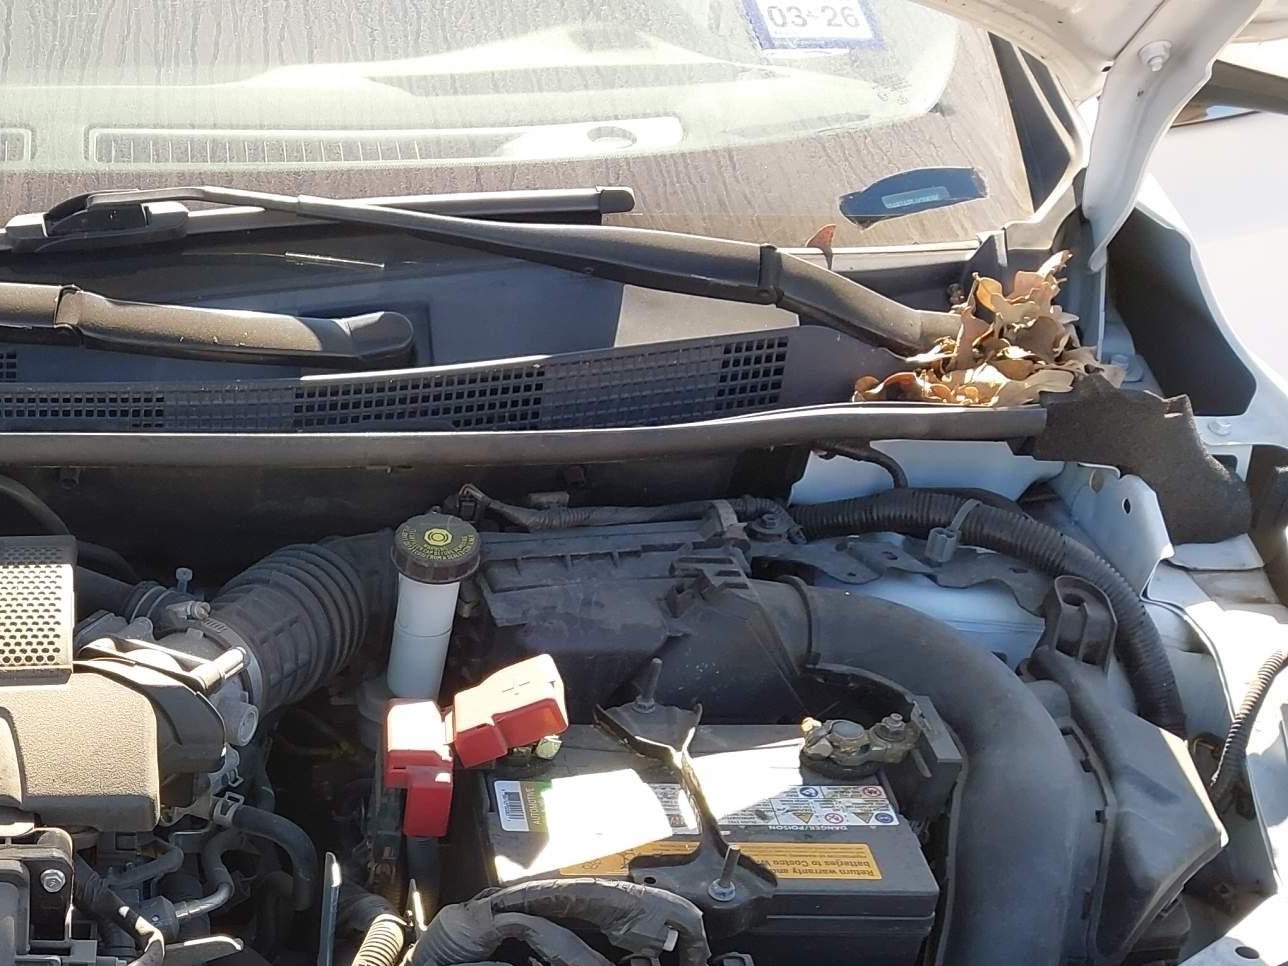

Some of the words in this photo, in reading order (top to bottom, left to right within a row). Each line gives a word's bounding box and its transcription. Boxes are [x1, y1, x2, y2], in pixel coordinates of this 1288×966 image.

[525, 786, 542, 825] AUTOMOTIVE
[772, 859, 809, 868] Costco
[811, 860, 823, 868] to
[824, 859, 871, 869] batteries
[792, 867, 838, 876] warranty
[838, 867, 875, 877] Return
